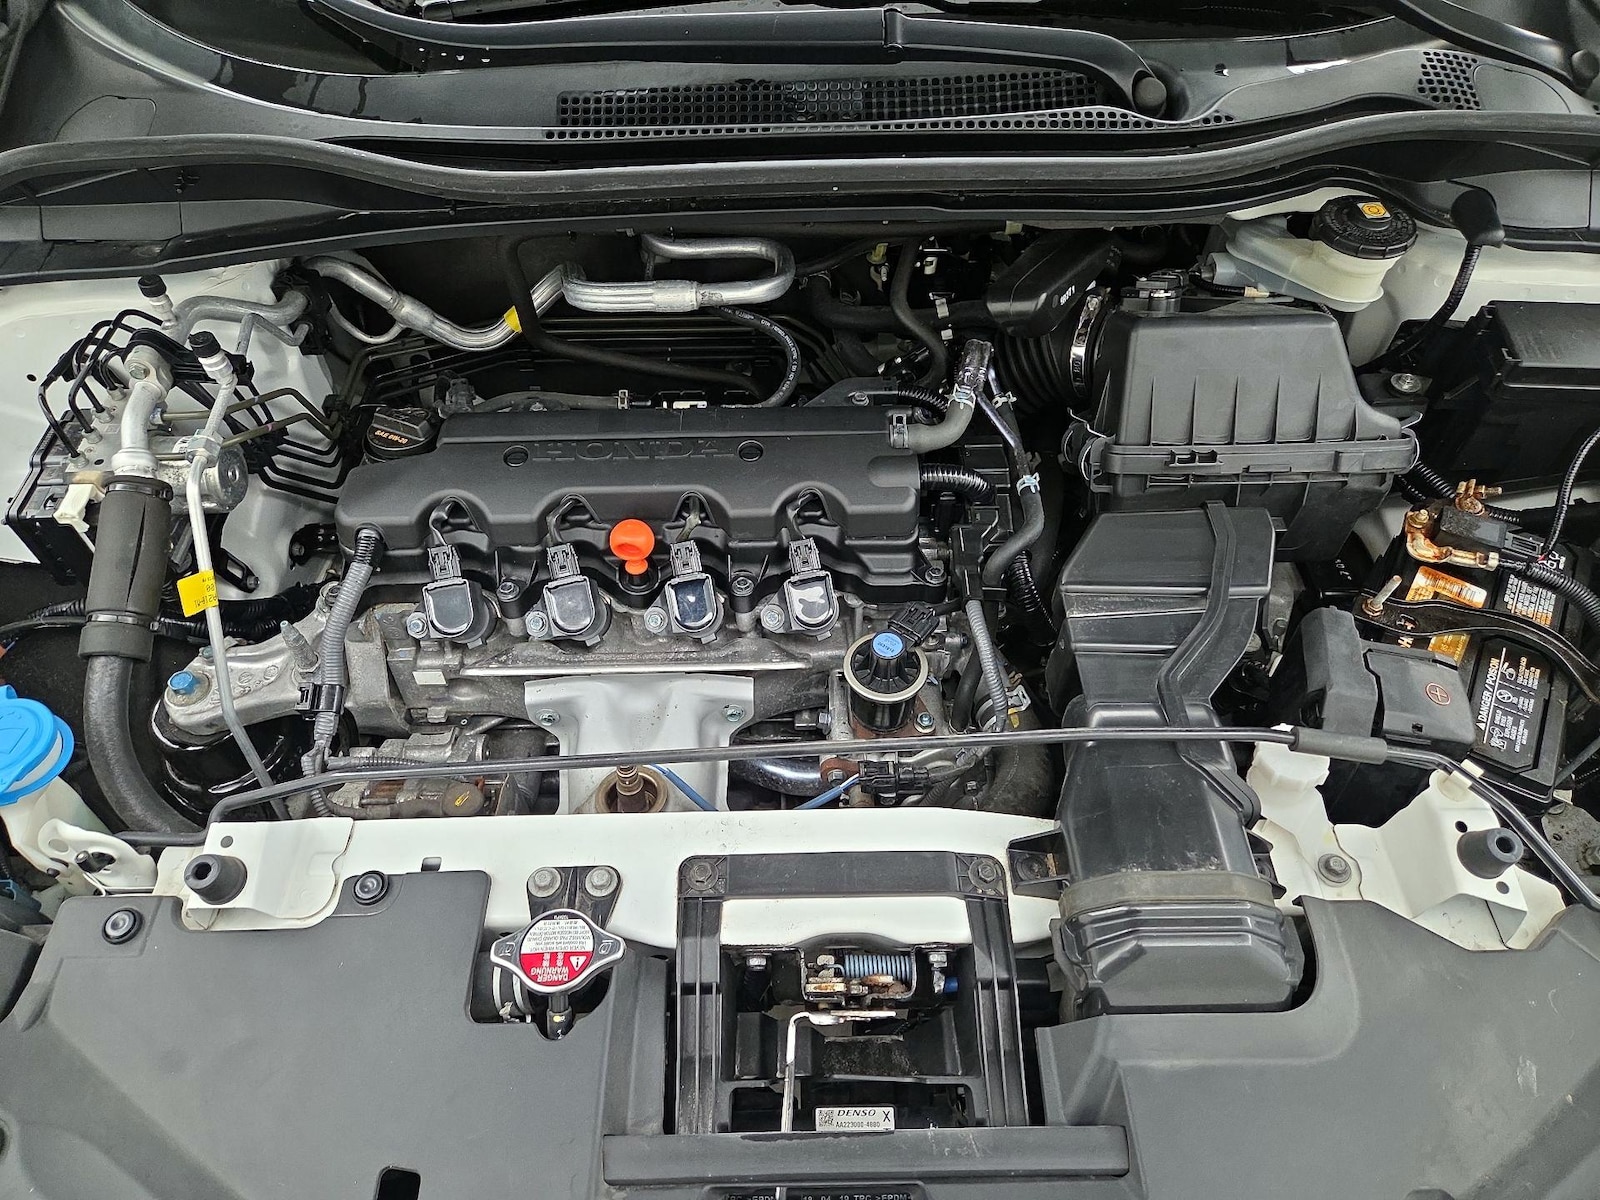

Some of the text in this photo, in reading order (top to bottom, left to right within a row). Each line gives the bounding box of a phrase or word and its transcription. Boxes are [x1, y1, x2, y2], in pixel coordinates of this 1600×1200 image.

[374, 429, 389, 438] SAE
[531, 440, 735, 461] HONDA
[1479, 690, 1491, 722] DANGER
[1486, 657, 1500, 685] POISON
[531, 966, 569, 975] WARNUNG
[536, 974, 569, 982] DANGER
[837, 1109, 891, 1122] DENSO X
